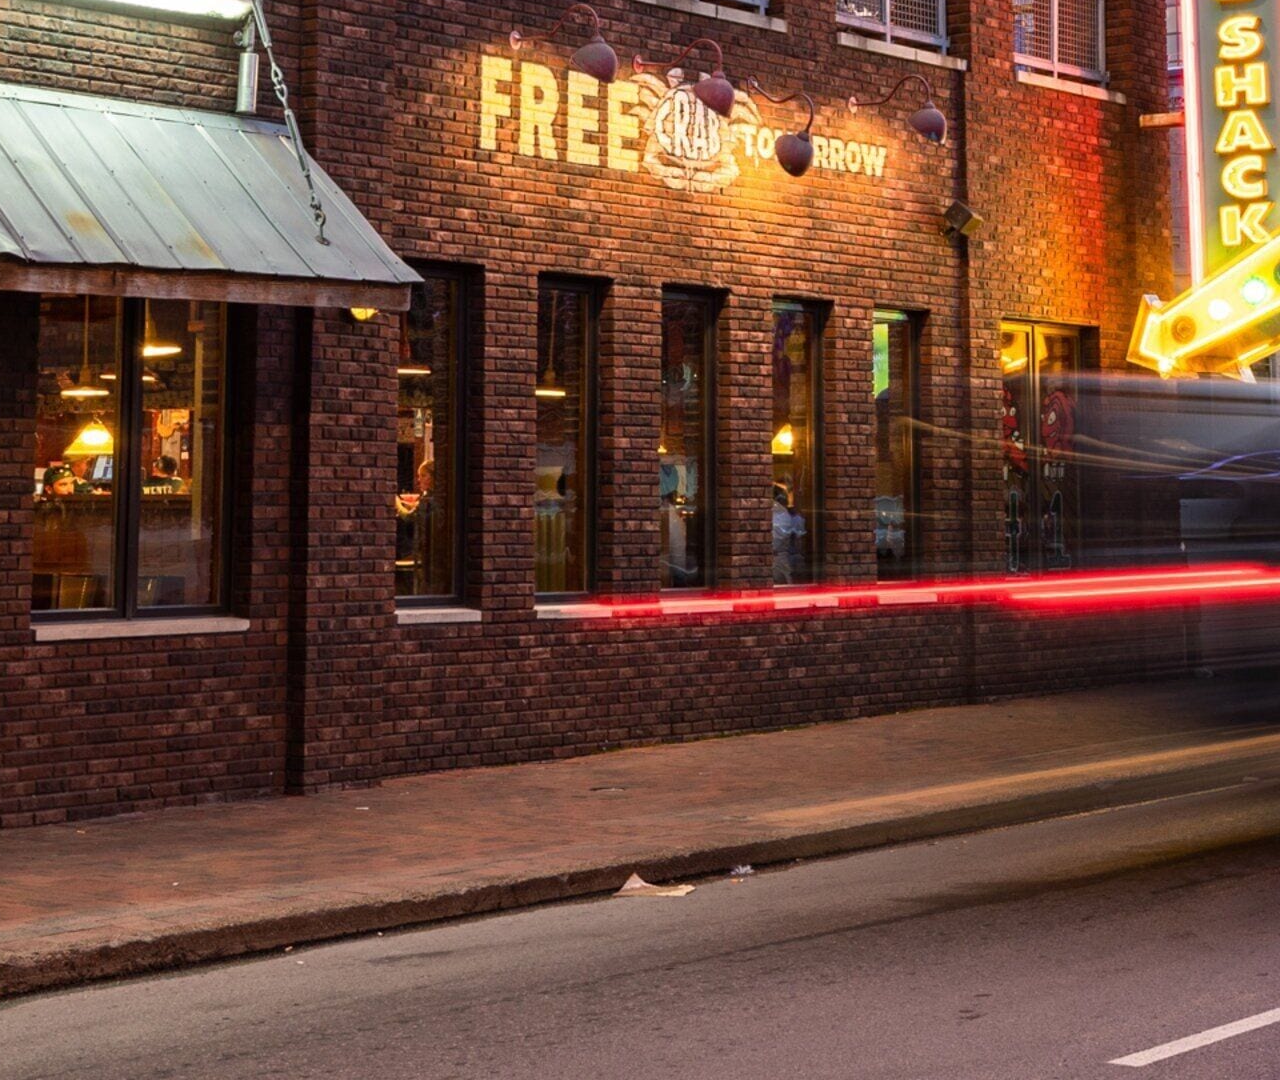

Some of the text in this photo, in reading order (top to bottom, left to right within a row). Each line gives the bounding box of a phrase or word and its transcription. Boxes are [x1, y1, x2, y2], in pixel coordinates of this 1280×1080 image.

[479, 55, 887, 177] FREE CRAB TORROW
[1215, 16, 1276, 248] SHACK
